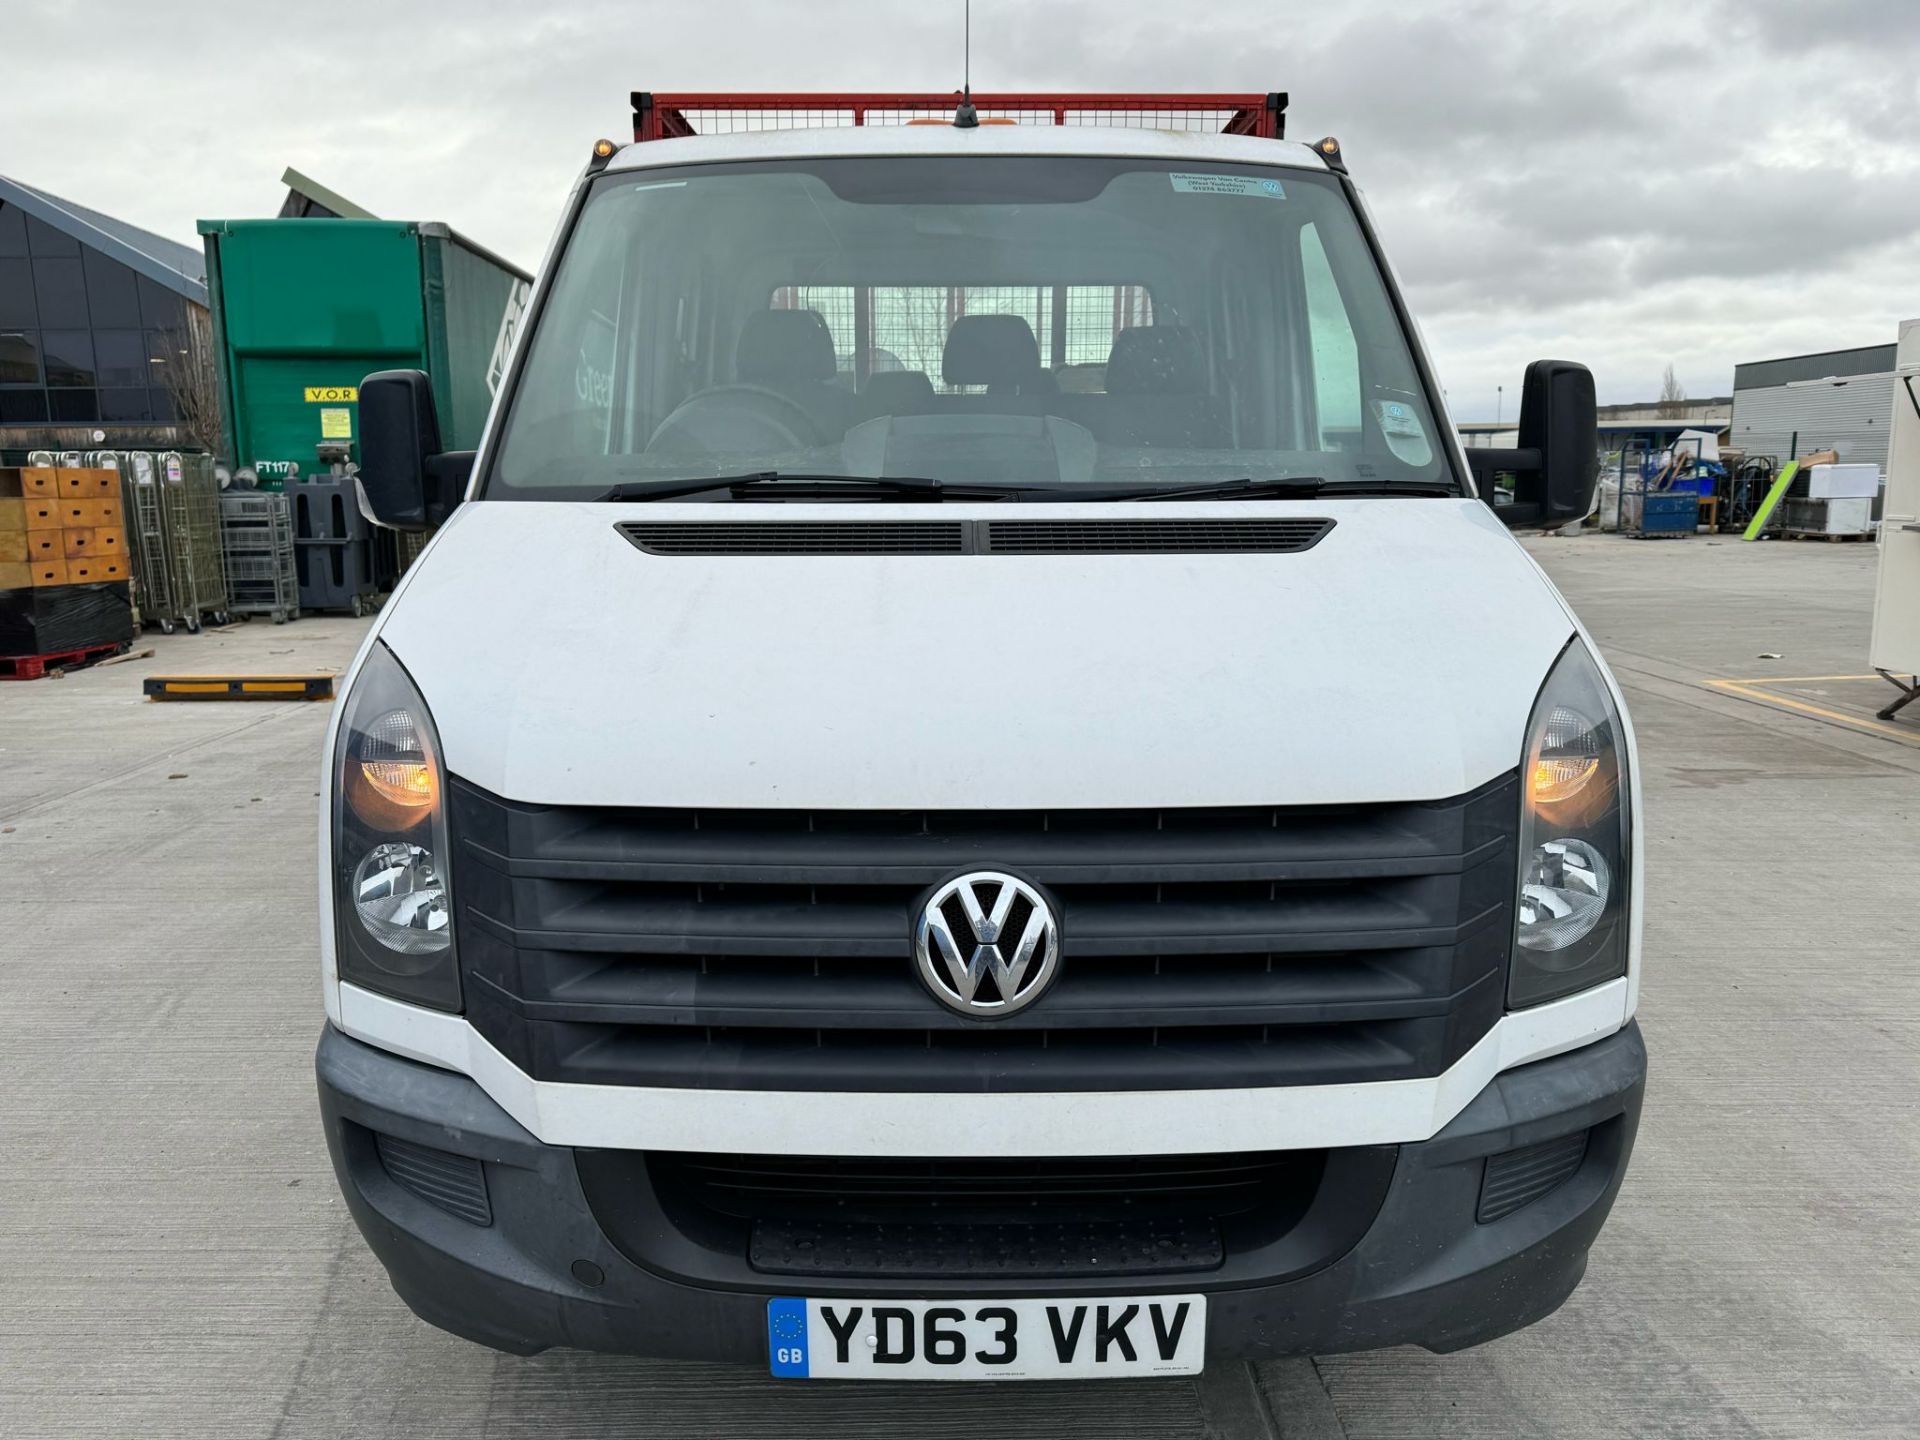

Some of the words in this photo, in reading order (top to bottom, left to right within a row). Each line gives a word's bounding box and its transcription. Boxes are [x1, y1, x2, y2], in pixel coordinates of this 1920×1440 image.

[311, 389, 351, 400] V.O.R
[916, 871, 1058, 1016] VW
[819, 1305, 1017, 1365] YD63
[1045, 1302, 1191, 1364] VKV
[777, 1348, 803, 1364] GB
